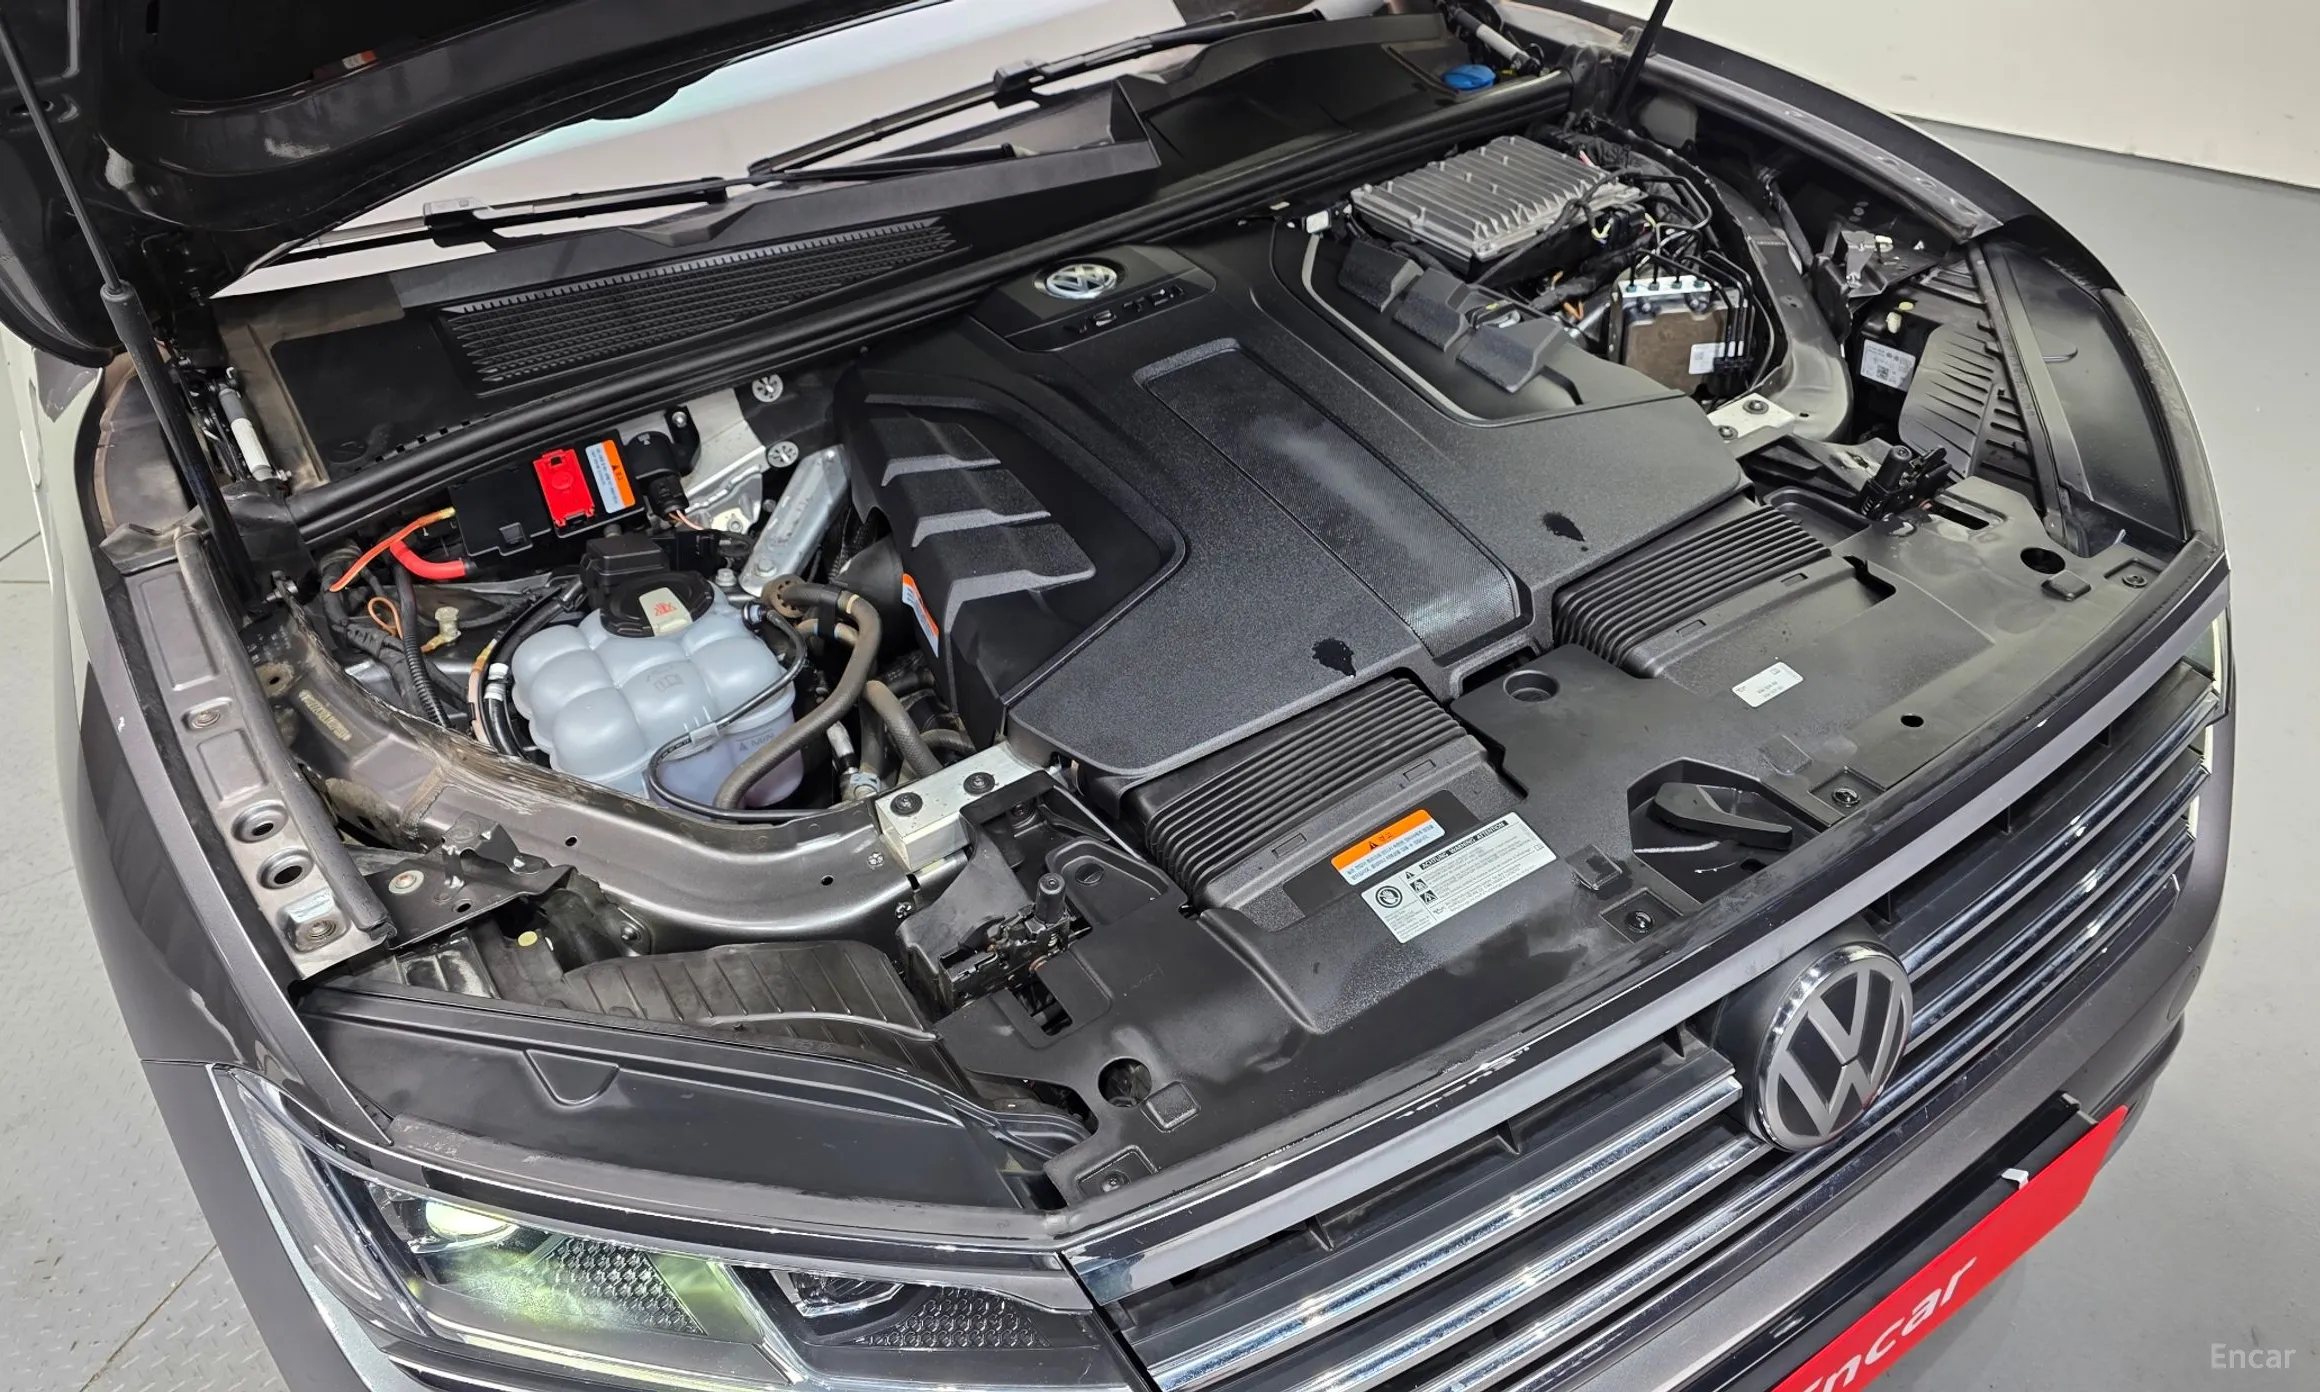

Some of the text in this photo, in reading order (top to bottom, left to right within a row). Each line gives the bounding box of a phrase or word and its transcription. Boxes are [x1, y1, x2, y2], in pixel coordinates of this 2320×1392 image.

[1420, 821, 1505, 870] ACHTUNG WARNING ATTENTION
